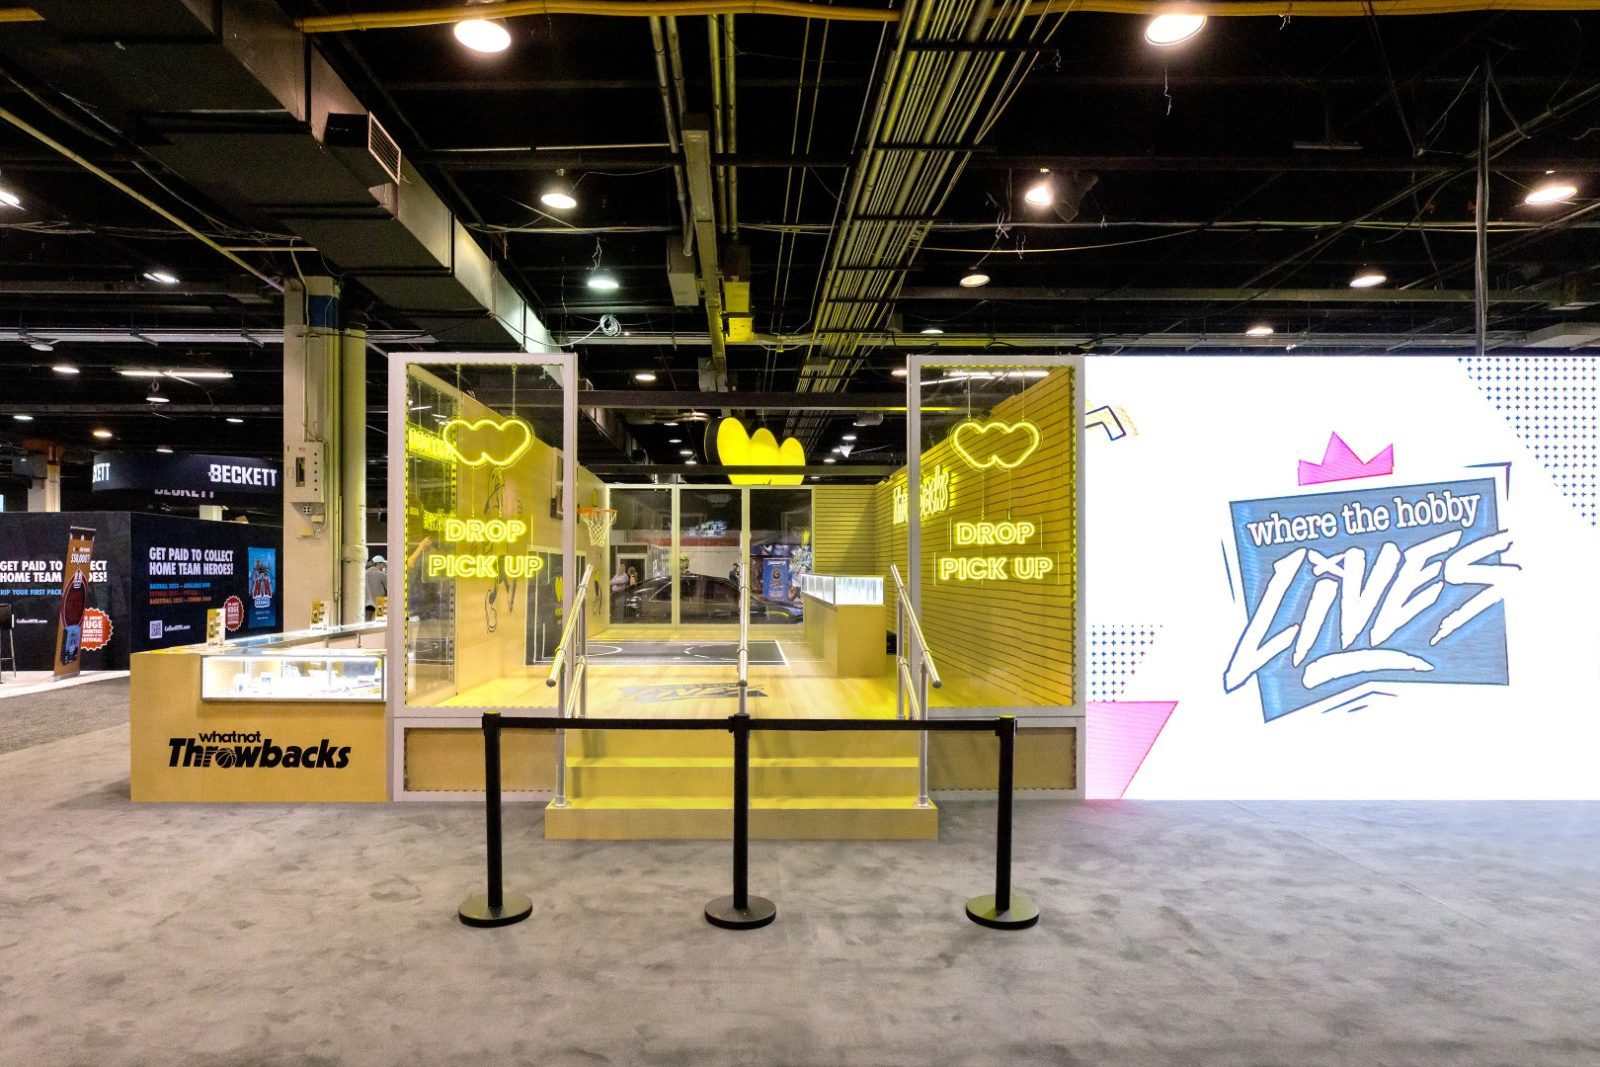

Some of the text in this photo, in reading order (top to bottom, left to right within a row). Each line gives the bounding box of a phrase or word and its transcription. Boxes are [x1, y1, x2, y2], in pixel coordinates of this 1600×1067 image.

[208, 463, 277, 487] BECKETT
[1247, 490, 1481, 547] where the hobby
[445, 519, 527, 543] DROP
[956, 521, 1036, 546] DROP
[0, 560, 63, 572] GET PAID TO
[149, 547, 233, 563] GET PAID TO COLLECT
[428, 553, 544, 578] PICK UP
[0, 572, 62, 583] HOME TEAM
[149, 562, 234, 576] HOME TEAM HEROES!
[940, 556, 1053, 581] PICK UP
[1223, 529, 1522, 694] LIVES
[199, 730, 261, 743] whatnot
[168, 737, 352, 769] Throwbacks
